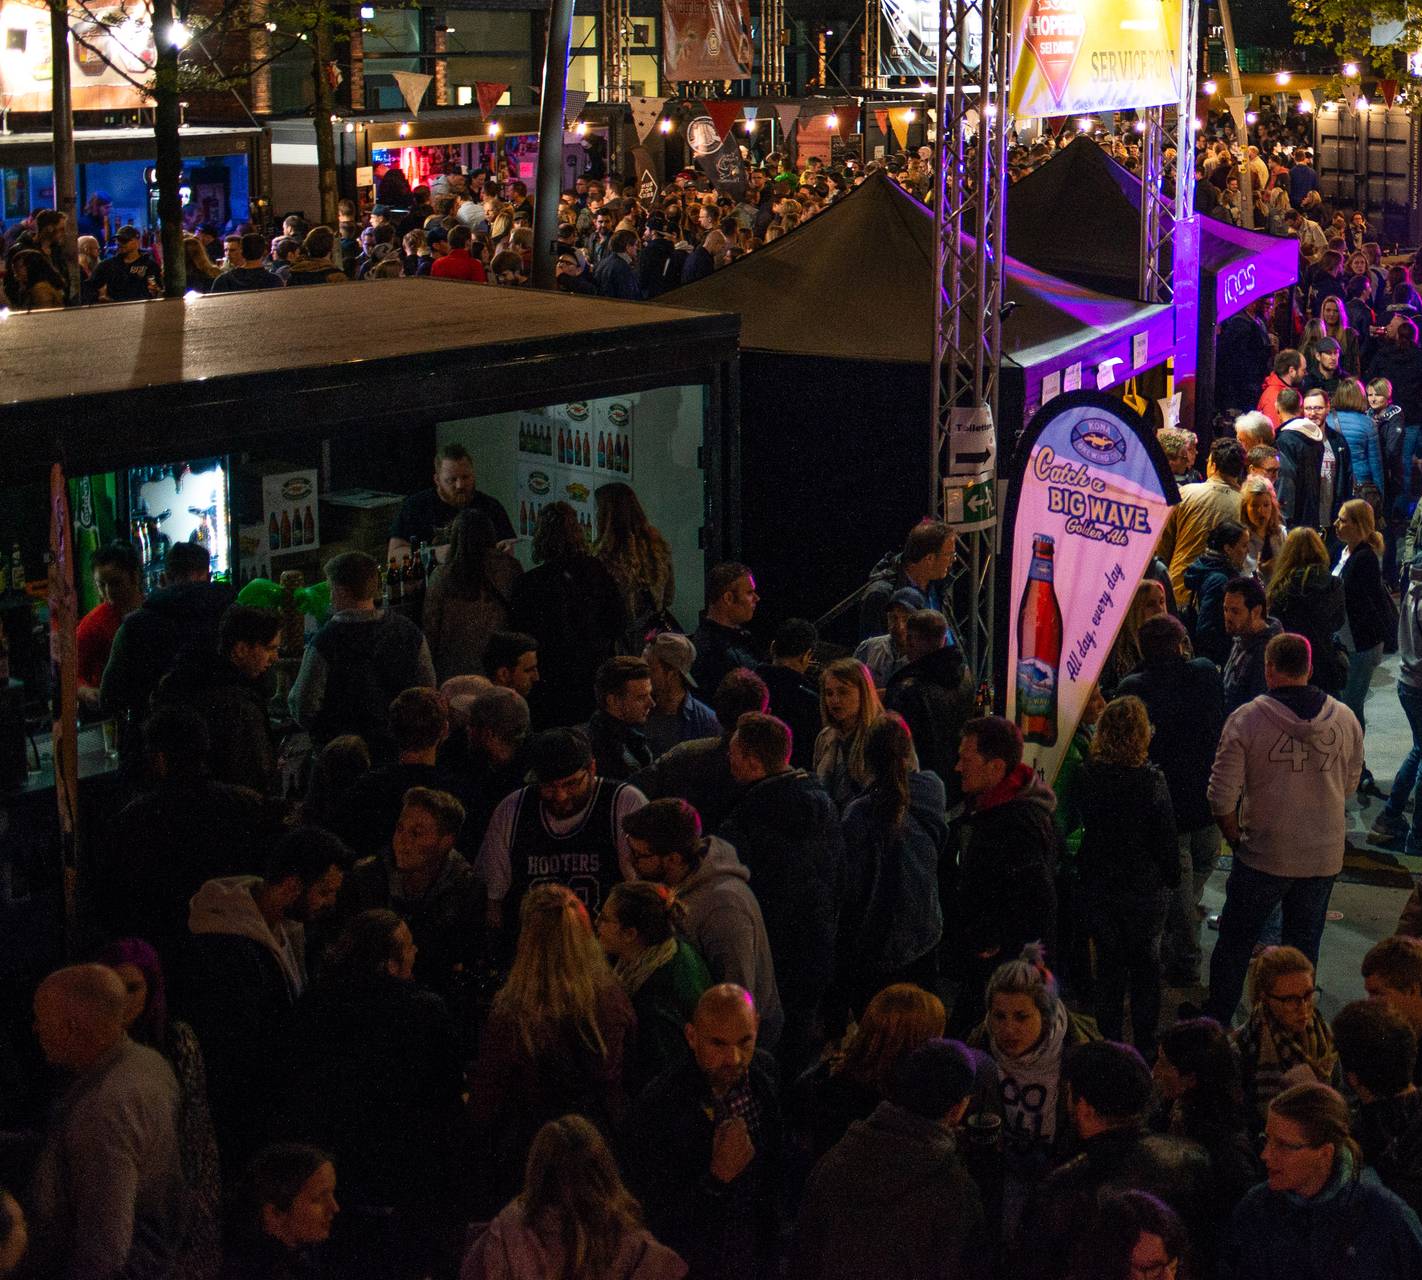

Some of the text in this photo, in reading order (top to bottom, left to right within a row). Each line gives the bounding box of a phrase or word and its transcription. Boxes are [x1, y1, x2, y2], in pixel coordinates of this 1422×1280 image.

[1091, 50, 1146, 82] SERVICE
[1224, 263, 1256, 305] IQOS
[1088, 421, 1112, 436] KONA
[1034, 445, 1106, 492] Catch a
[1048, 486, 1086, 518] BIG
[1065, 517, 1129, 546] Golden Ale
[1066, 562, 1125, 683] All day, every day
[1269, 720, 1344, 772] 49
[527, 854, 600, 876] HOOTERS
